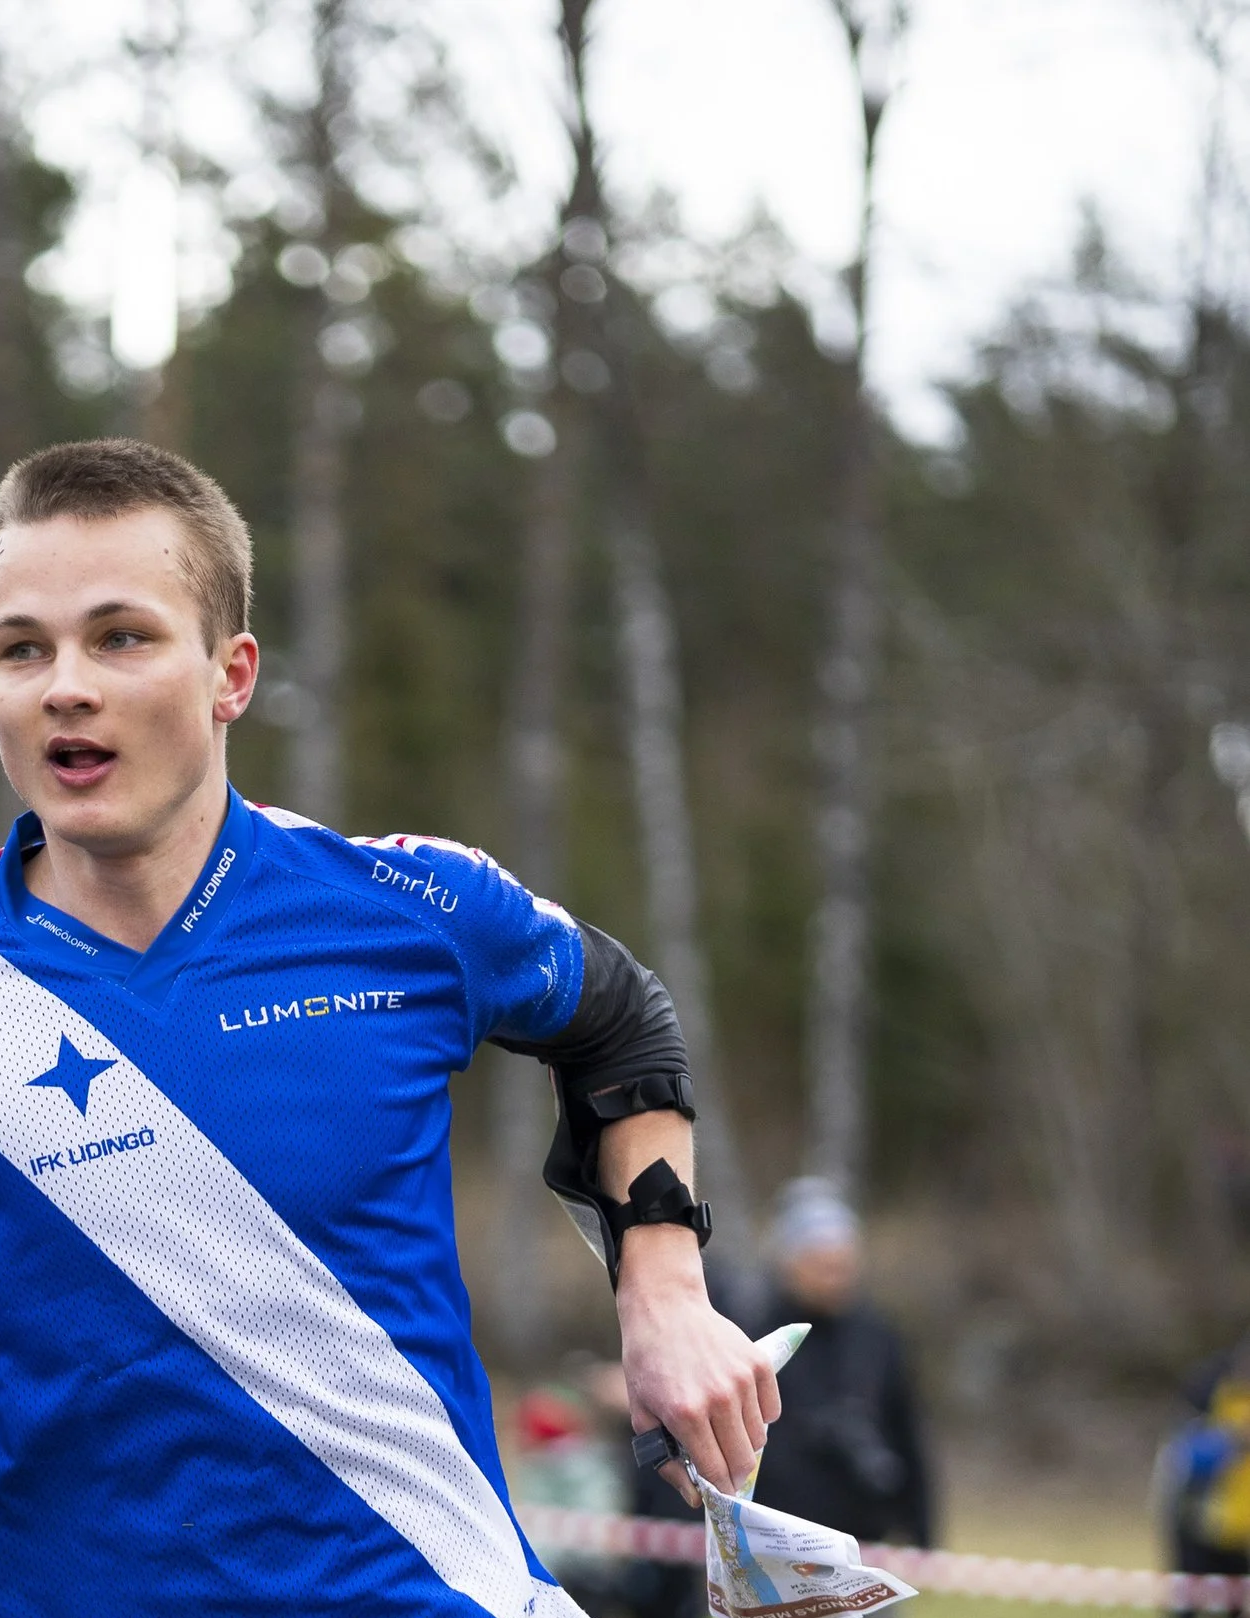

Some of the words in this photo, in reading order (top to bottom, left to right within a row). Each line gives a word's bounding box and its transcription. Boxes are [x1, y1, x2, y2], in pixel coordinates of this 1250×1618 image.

[181, 905, 203, 933] IFK
[197, 847, 237, 908] LIDINGÖ
[38, 918, 99, 957] LIDINGÖLOPPET
[219, 991, 405, 1032] LUMONITE
[29, 1151, 67, 1176] IFK
[68, 1124, 155, 1165] LIDINGÖ
[794, 1588, 889, 1616] ATTUNDAS
